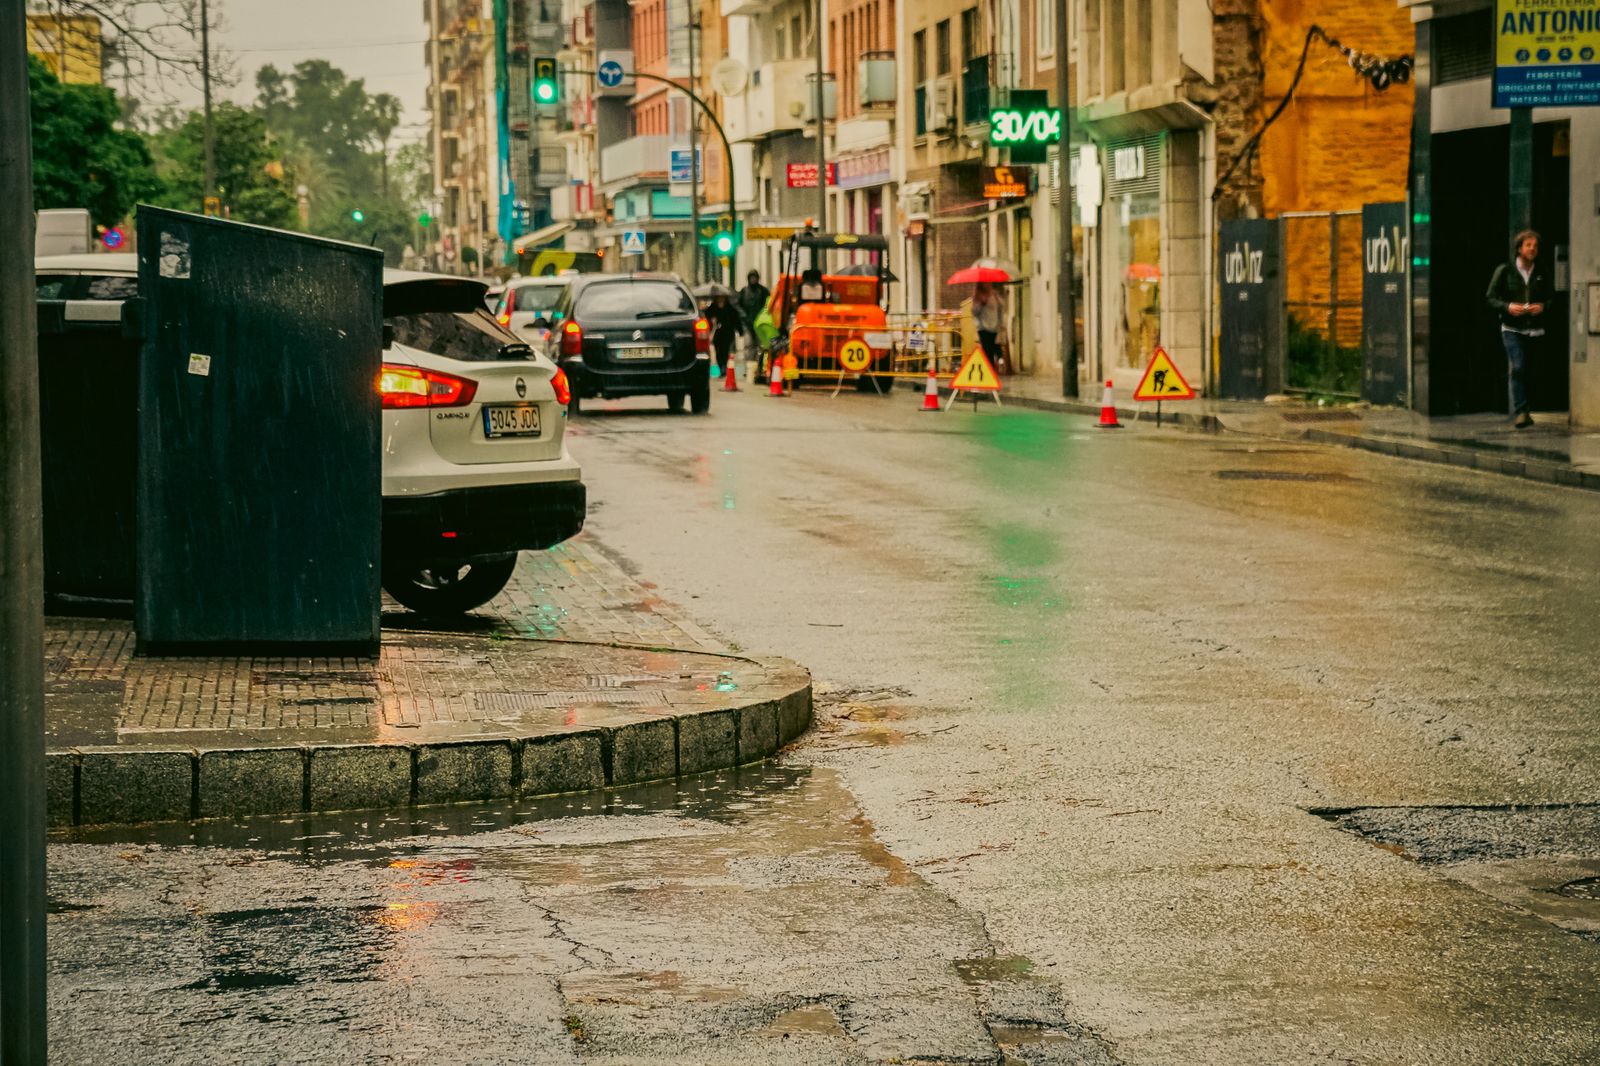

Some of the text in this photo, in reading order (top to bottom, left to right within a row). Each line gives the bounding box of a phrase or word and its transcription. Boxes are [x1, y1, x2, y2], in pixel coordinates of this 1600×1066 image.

[991, 110, 1060, 141] 30/04
[847, 348, 865, 362] 20
[490, 409, 538, 430] 5045 JDC
